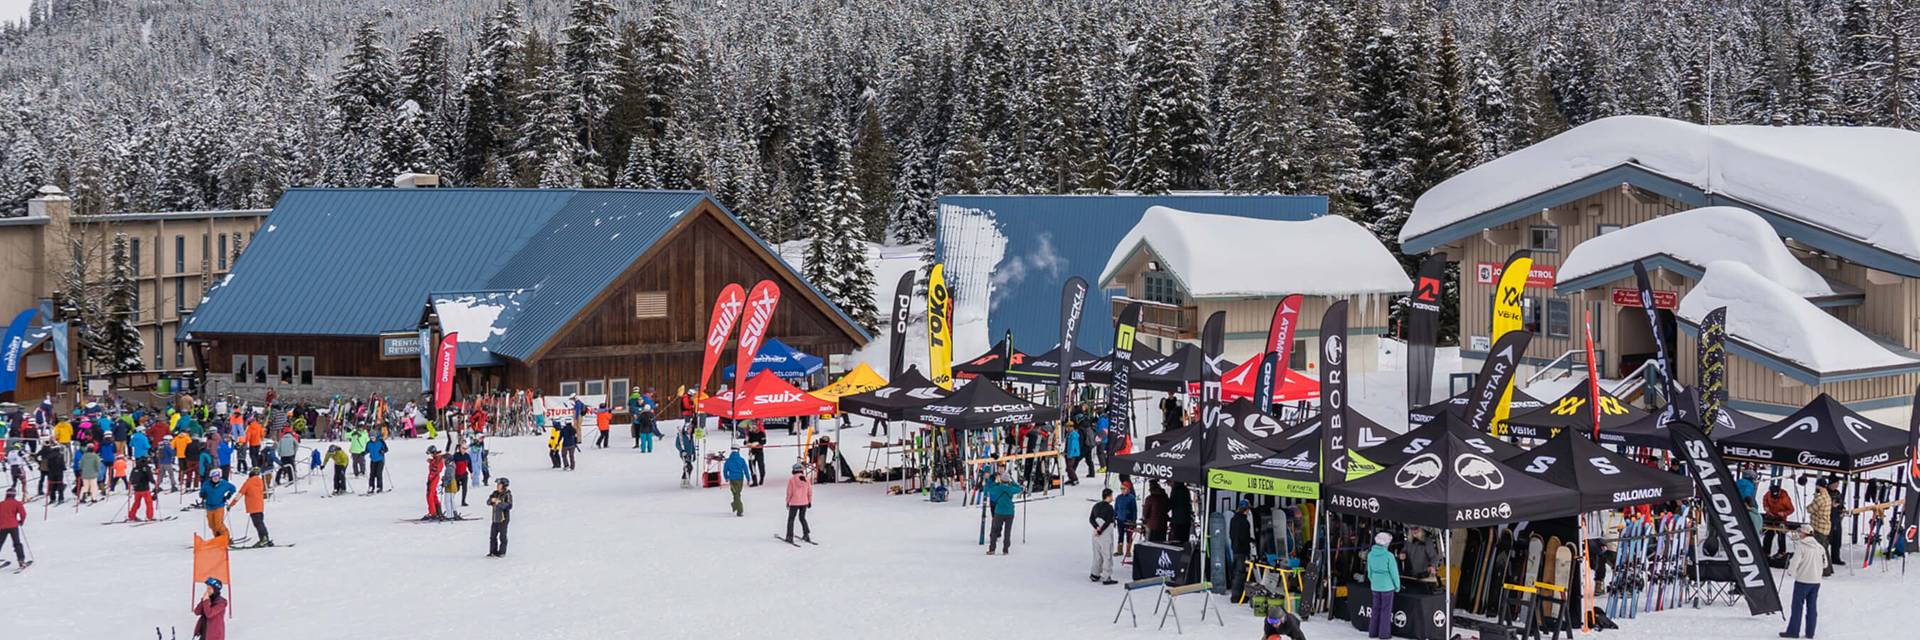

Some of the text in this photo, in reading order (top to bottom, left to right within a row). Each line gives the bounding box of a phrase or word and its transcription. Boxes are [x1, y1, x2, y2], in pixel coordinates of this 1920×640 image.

[1527, 269, 1553, 279] ATROL
[930, 284, 947, 347] TOKO
[442, 351, 451, 382] ATOMIC
[1115, 350, 1131, 360] NOW
[1110, 371, 1122, 433] RETHINK
[1117, 364, 1130, 439] YOUR RIDE
[1472, 362, 1508, 430] YNASTAR
[1331, 369, 1346, 474] ARBOR
[1723, 446, 1773, 458] HEAD
[1854, 452, 1889, 467] HEAD
[1331, 494, 1368, 510] ARBOR
[1613, 488, 1663, 502] SALOMON
[1456, 506, 1499, 521] ARBOR
[1685, 439, 1765, 588] SALOMON
